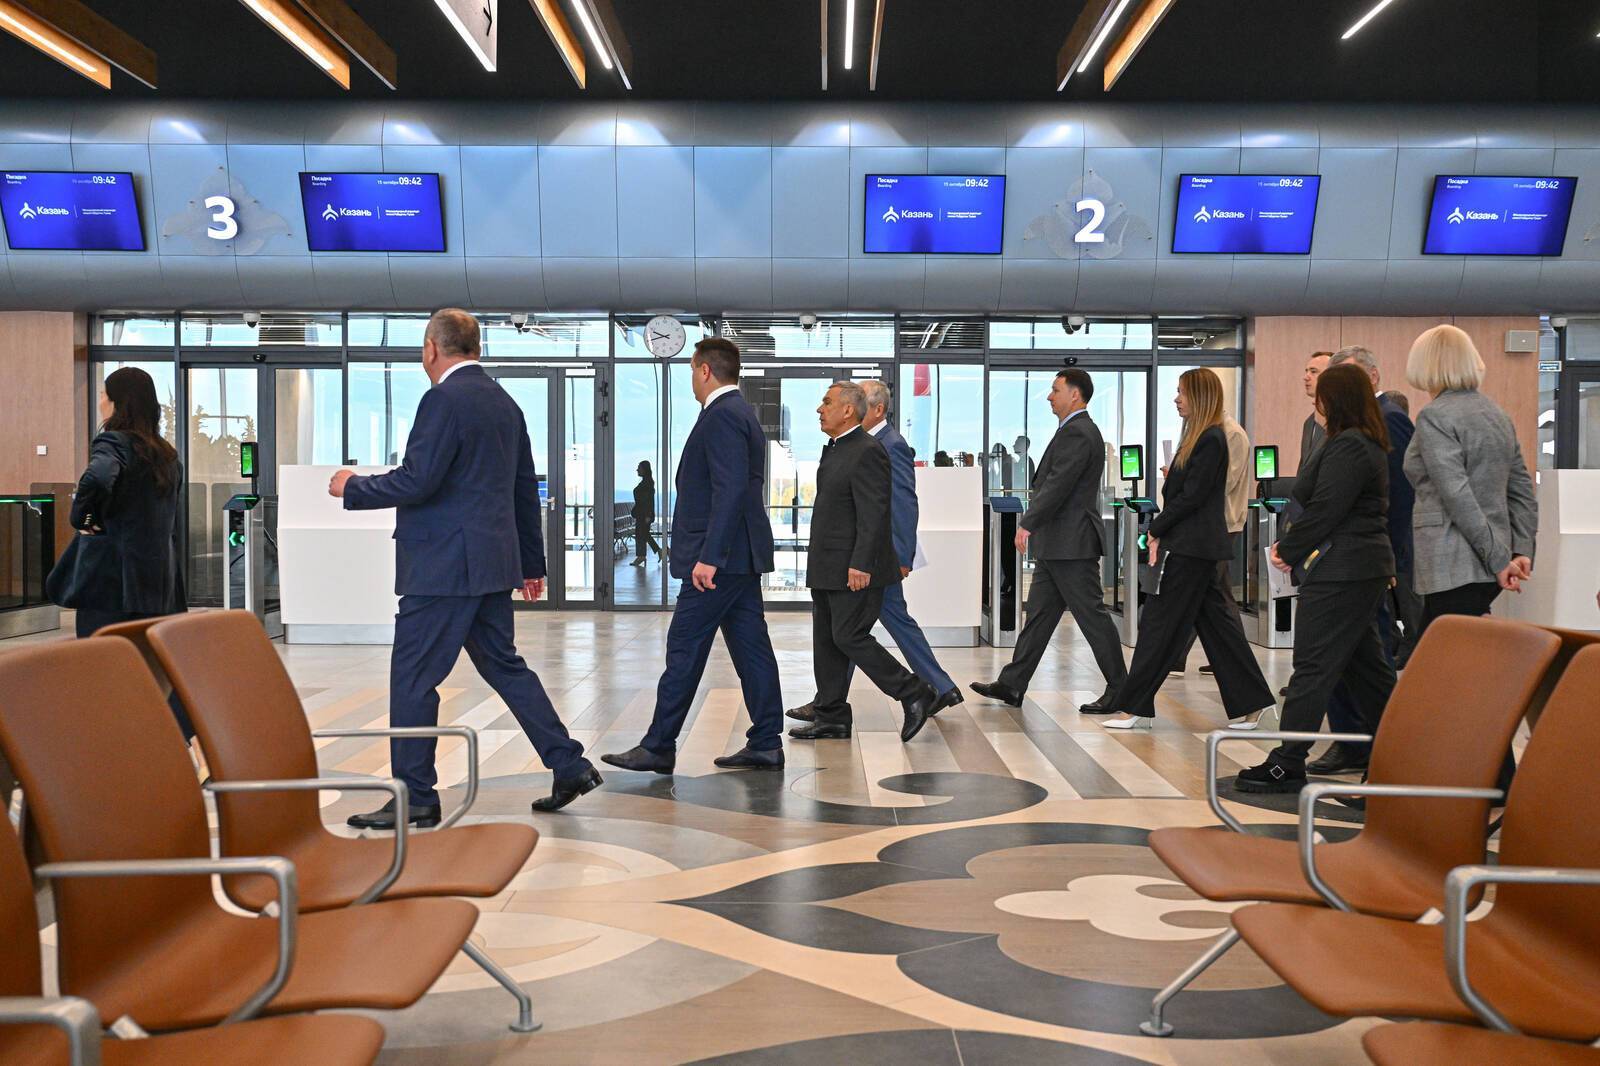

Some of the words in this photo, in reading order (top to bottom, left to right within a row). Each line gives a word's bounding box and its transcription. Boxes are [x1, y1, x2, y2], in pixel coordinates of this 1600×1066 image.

[92, 175, 116, 185] 09:42
[398, 176, 422, 185] 09:42
[965, 178, 989, 187] 09:42
[1279, 178, 1303, 187] 09:42
[1535, 180, 1560, 189] 09:42
[36, 205, 70, 215] Казань
[339, 207, 372, 216] Казань
[901, 209, 933, 218] Казань
[1212, 208, 1245, 218] Казань
[205, 195, 239, 240] 3
[1465, 210, 1498, 220] Казань
[1074, 199, 1105, 243] 2
